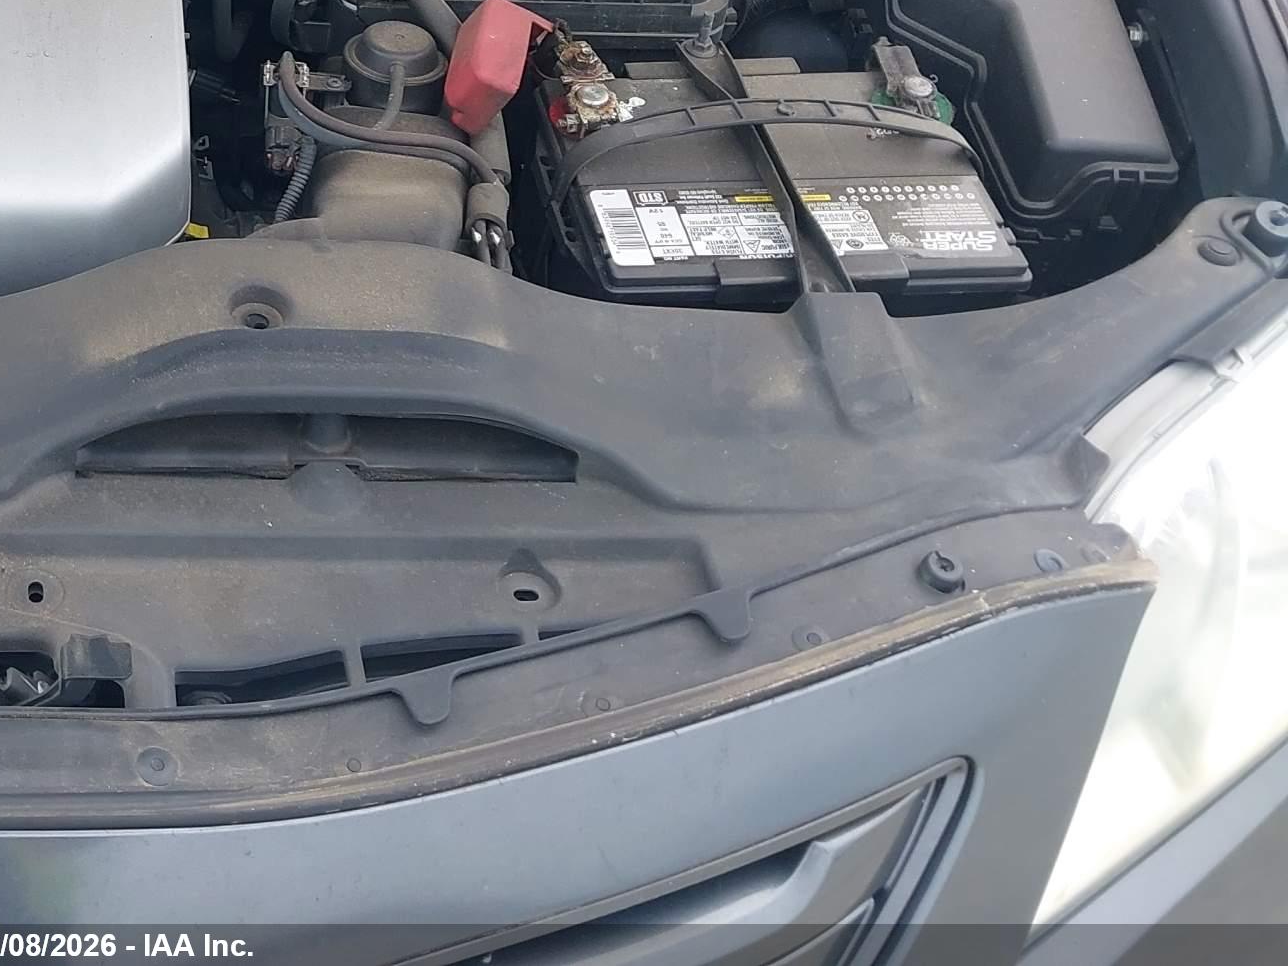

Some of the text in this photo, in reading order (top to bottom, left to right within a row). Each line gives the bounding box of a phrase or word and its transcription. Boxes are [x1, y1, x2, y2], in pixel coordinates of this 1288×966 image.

[637, 192, 665, 203] STD
[919, 230, 998, 243] START
[922, 241, 994, 251] SUPER
